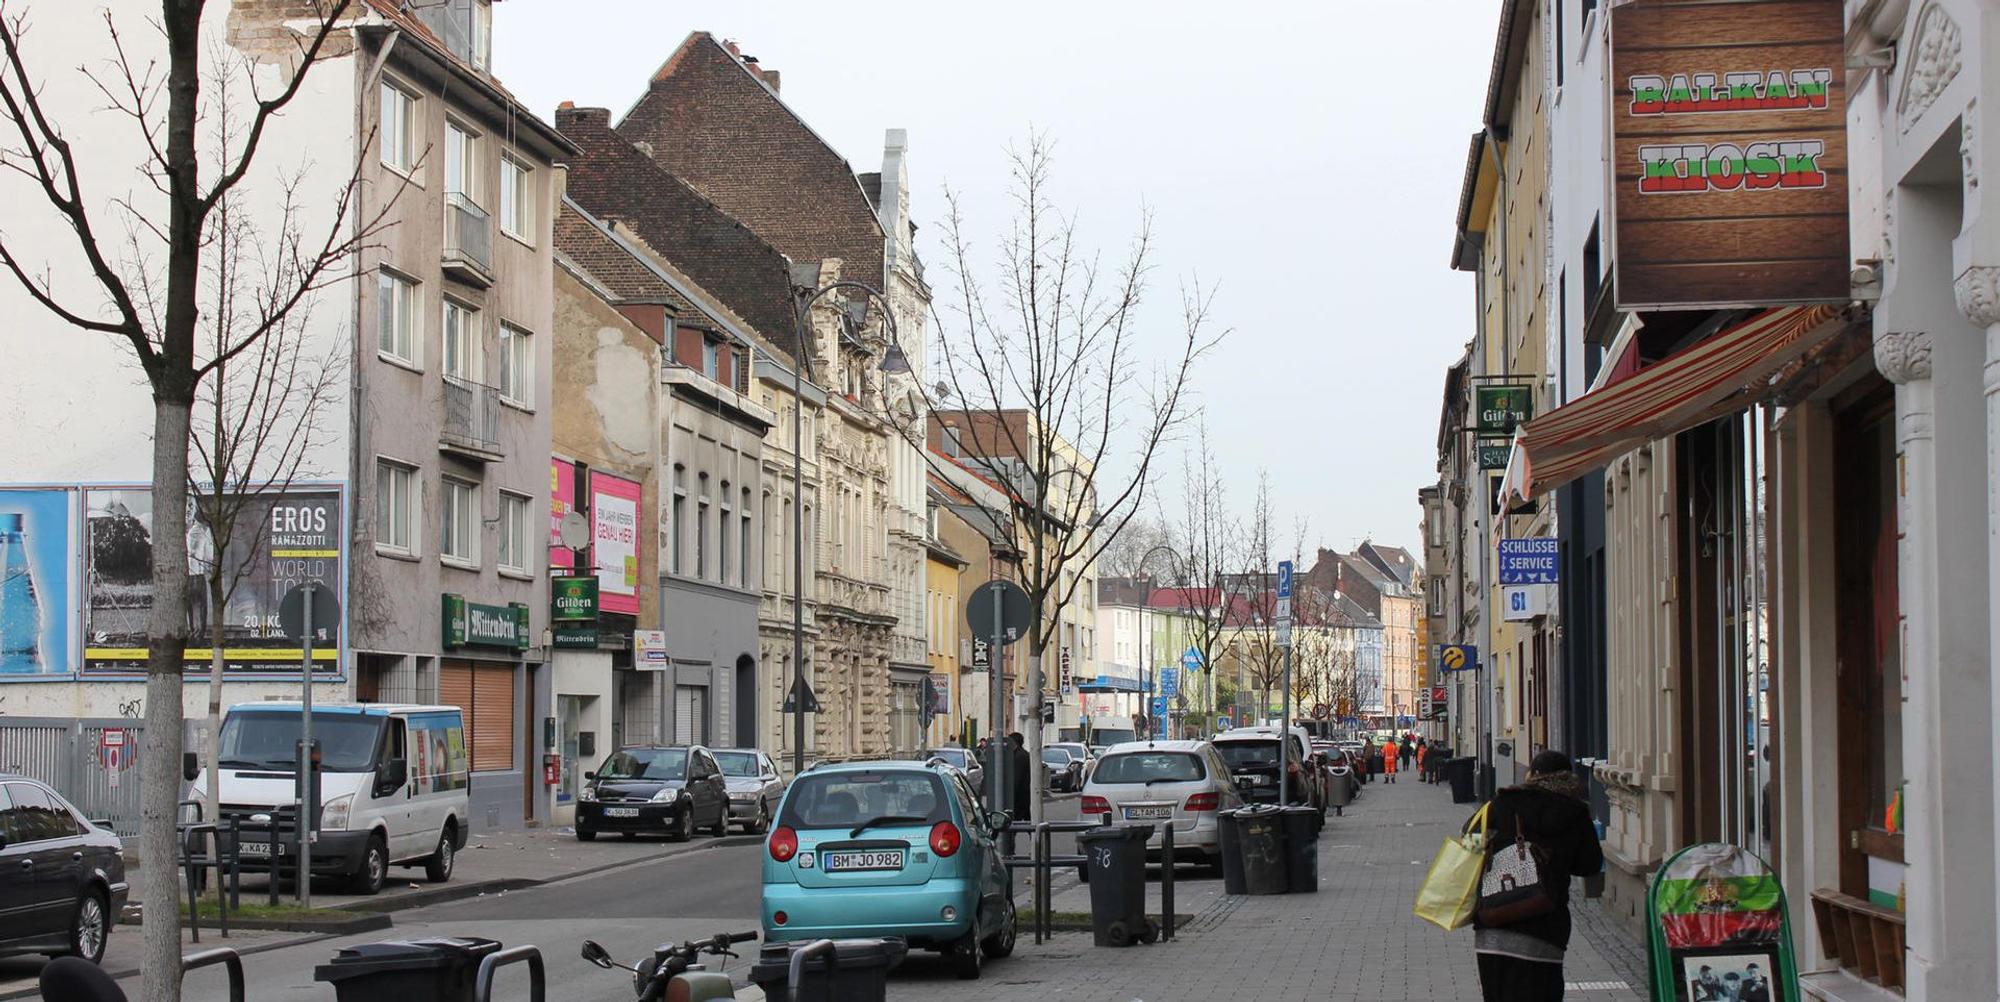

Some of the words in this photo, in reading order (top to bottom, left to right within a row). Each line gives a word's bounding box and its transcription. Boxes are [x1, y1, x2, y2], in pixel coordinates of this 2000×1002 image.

[1630, 69, 1832, 116] BALKAN
[1639, 139, 1827, 194] KIOSK
[272, 506, 326, 532] EROS
[271, 535, 326, 545] RAMAZZOTTI
[272, 560, 325, 577] WORLD
[1509, 557, 1553, 570] SERVICE
[556, 596, 591, 608] Gilden
[1511, 591, 1526, 612] 61
[244, 615, 261, 628] 20.
[1061, 646, 1070, 686] TAPETEN
[833, 855, 850, 867] BM
[858, 854, 875, 867] JO
[878, 853, 901, 866] 982
[1094, 846, 1111, 868] 78
